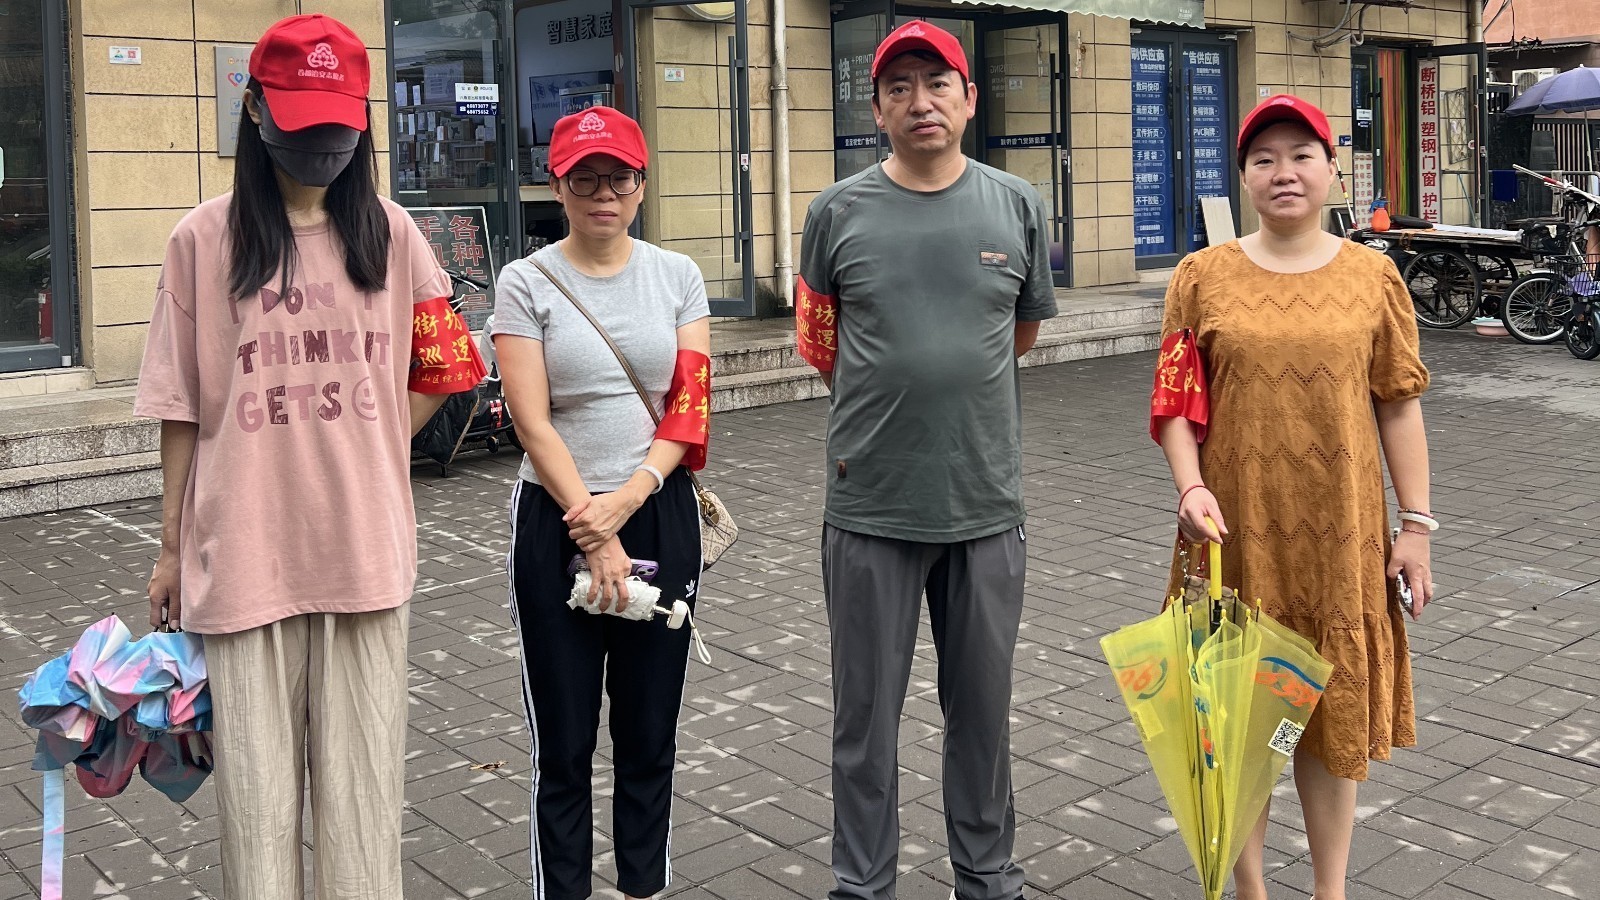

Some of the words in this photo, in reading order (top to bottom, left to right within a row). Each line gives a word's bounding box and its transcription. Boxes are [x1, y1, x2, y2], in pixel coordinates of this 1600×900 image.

[547, 11, 613, 45] 智慧家庭
[838, 58, 851, 103] 快印
[1421, 67, 1436, 116] 断桥铝
[1421, 122, 1437, 187] 塑钢门窗
[1422, 192, 1438, 224] 护栏
[413, 308, 463, 339] 街坊
[236, 329, 360, 375] THINK
[418, 334, 472, 370] 巡逻
[236, 381, 343, 434] GETS
